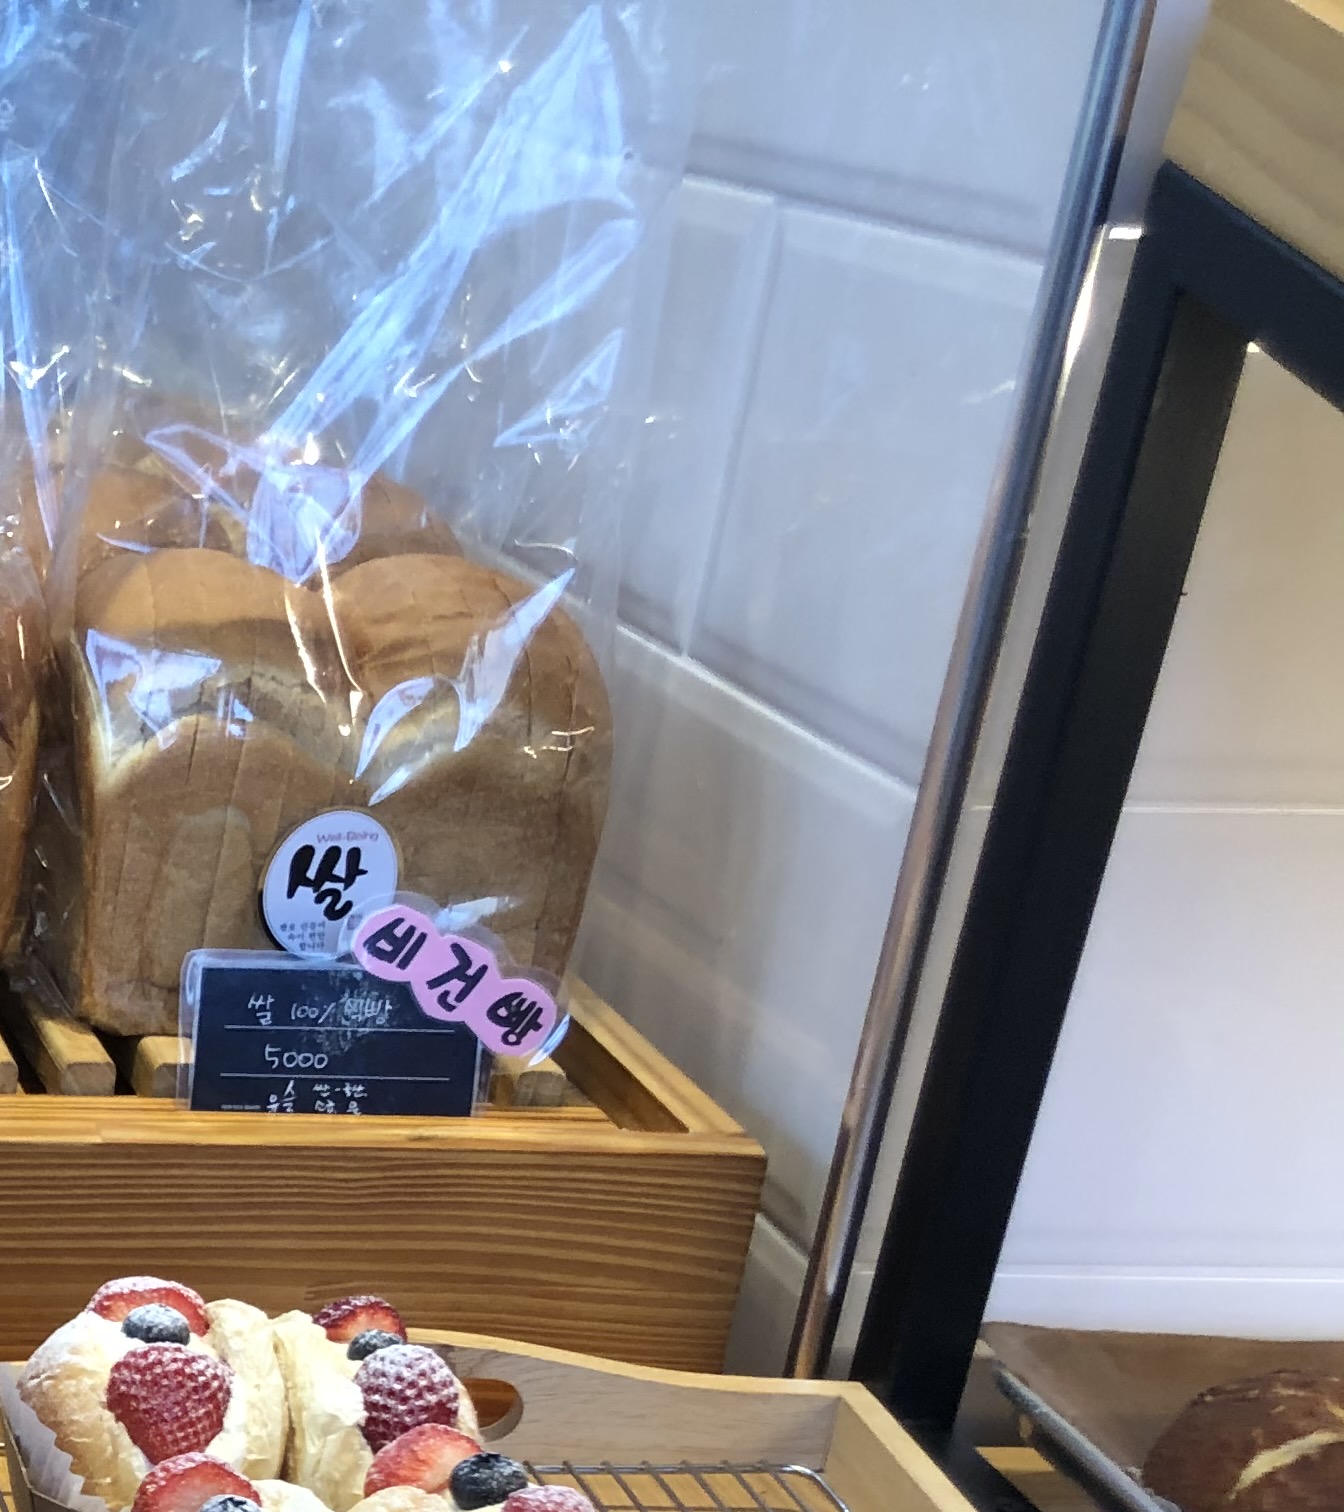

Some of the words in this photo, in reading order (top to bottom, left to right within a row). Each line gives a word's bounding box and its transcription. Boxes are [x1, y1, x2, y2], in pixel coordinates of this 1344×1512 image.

[286, 844, 368, 921] 쌀
[247, 991, 275, 1026] 쌀
[290, 1001, 337, 1025] 100%
[362, 917, 544, 1047] 비건빵
[264, 1043, 329, 1069] 5000
